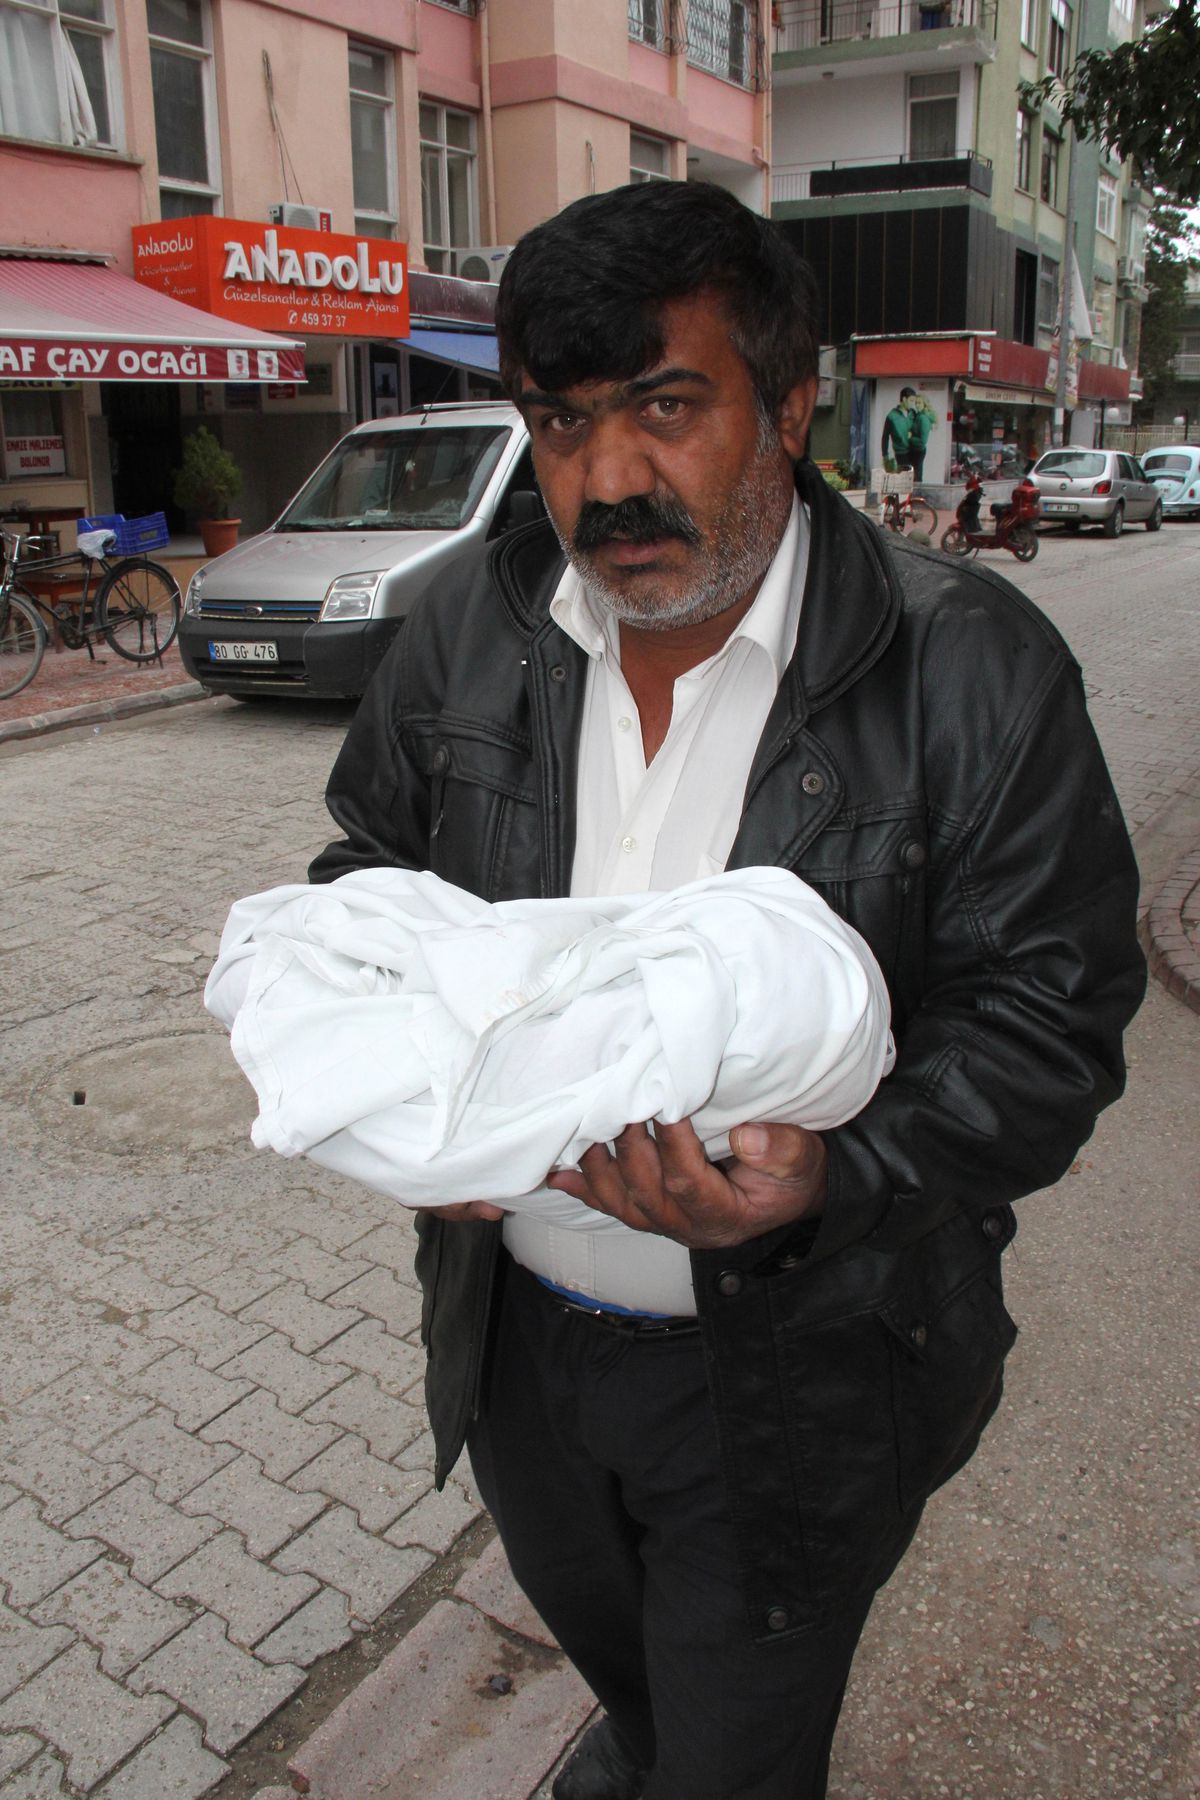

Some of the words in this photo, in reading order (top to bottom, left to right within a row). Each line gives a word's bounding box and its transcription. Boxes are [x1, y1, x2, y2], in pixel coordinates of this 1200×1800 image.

[138, 231, 194, 257] ANADOLU
[223, 229, 403, 295] ANADOLU
[223, 286, 309, 306] Güzelsanatlar
[311, 294, 321, 308] &
[322, 295, 363, 311] Reklam
[365, 299, 400, 317] Ajansı
[301, 311, 320, 327] 459
[321, 313, 333, 327] 37
[335, 315, 347, 328] 37
[47, 347, 110, 378] ÇAY
[118, 345, 208, 375] OCAĞI
[214, 645, 228, 659] 80
[254, 645, 276, 659] 476
